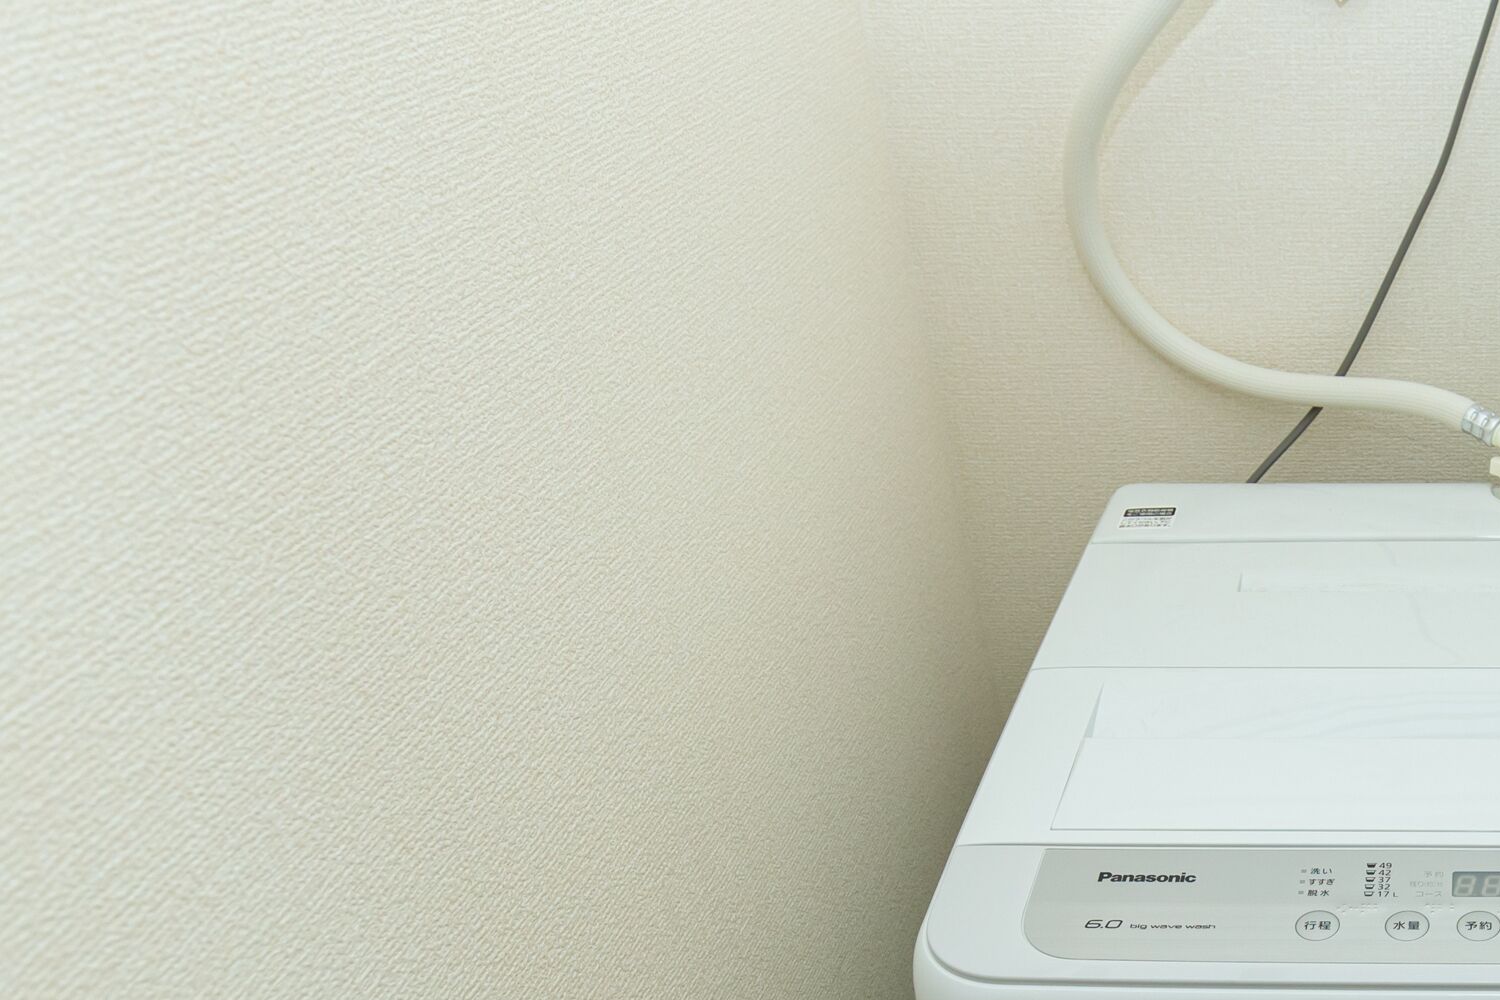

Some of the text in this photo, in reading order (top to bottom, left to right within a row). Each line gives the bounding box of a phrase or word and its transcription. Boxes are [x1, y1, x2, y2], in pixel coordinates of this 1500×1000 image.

[1310, 867, 1333, 875] 洗い
[1097, 871, 1197, 884] Panasonic
[1308, 878, 1335, 886] すすぎ
[1307, 889, 1330, 897] 脱水
[1084, 919, 1124, 930] 6.0
[1129, 922, 1148, 930] big
[1184, 922, 1216, 930] wash
[1304, 920, 1331, 931] 行程
[1392, 920, 1420, 931] 水量
[1464, 920, 1493, 932] 予約
